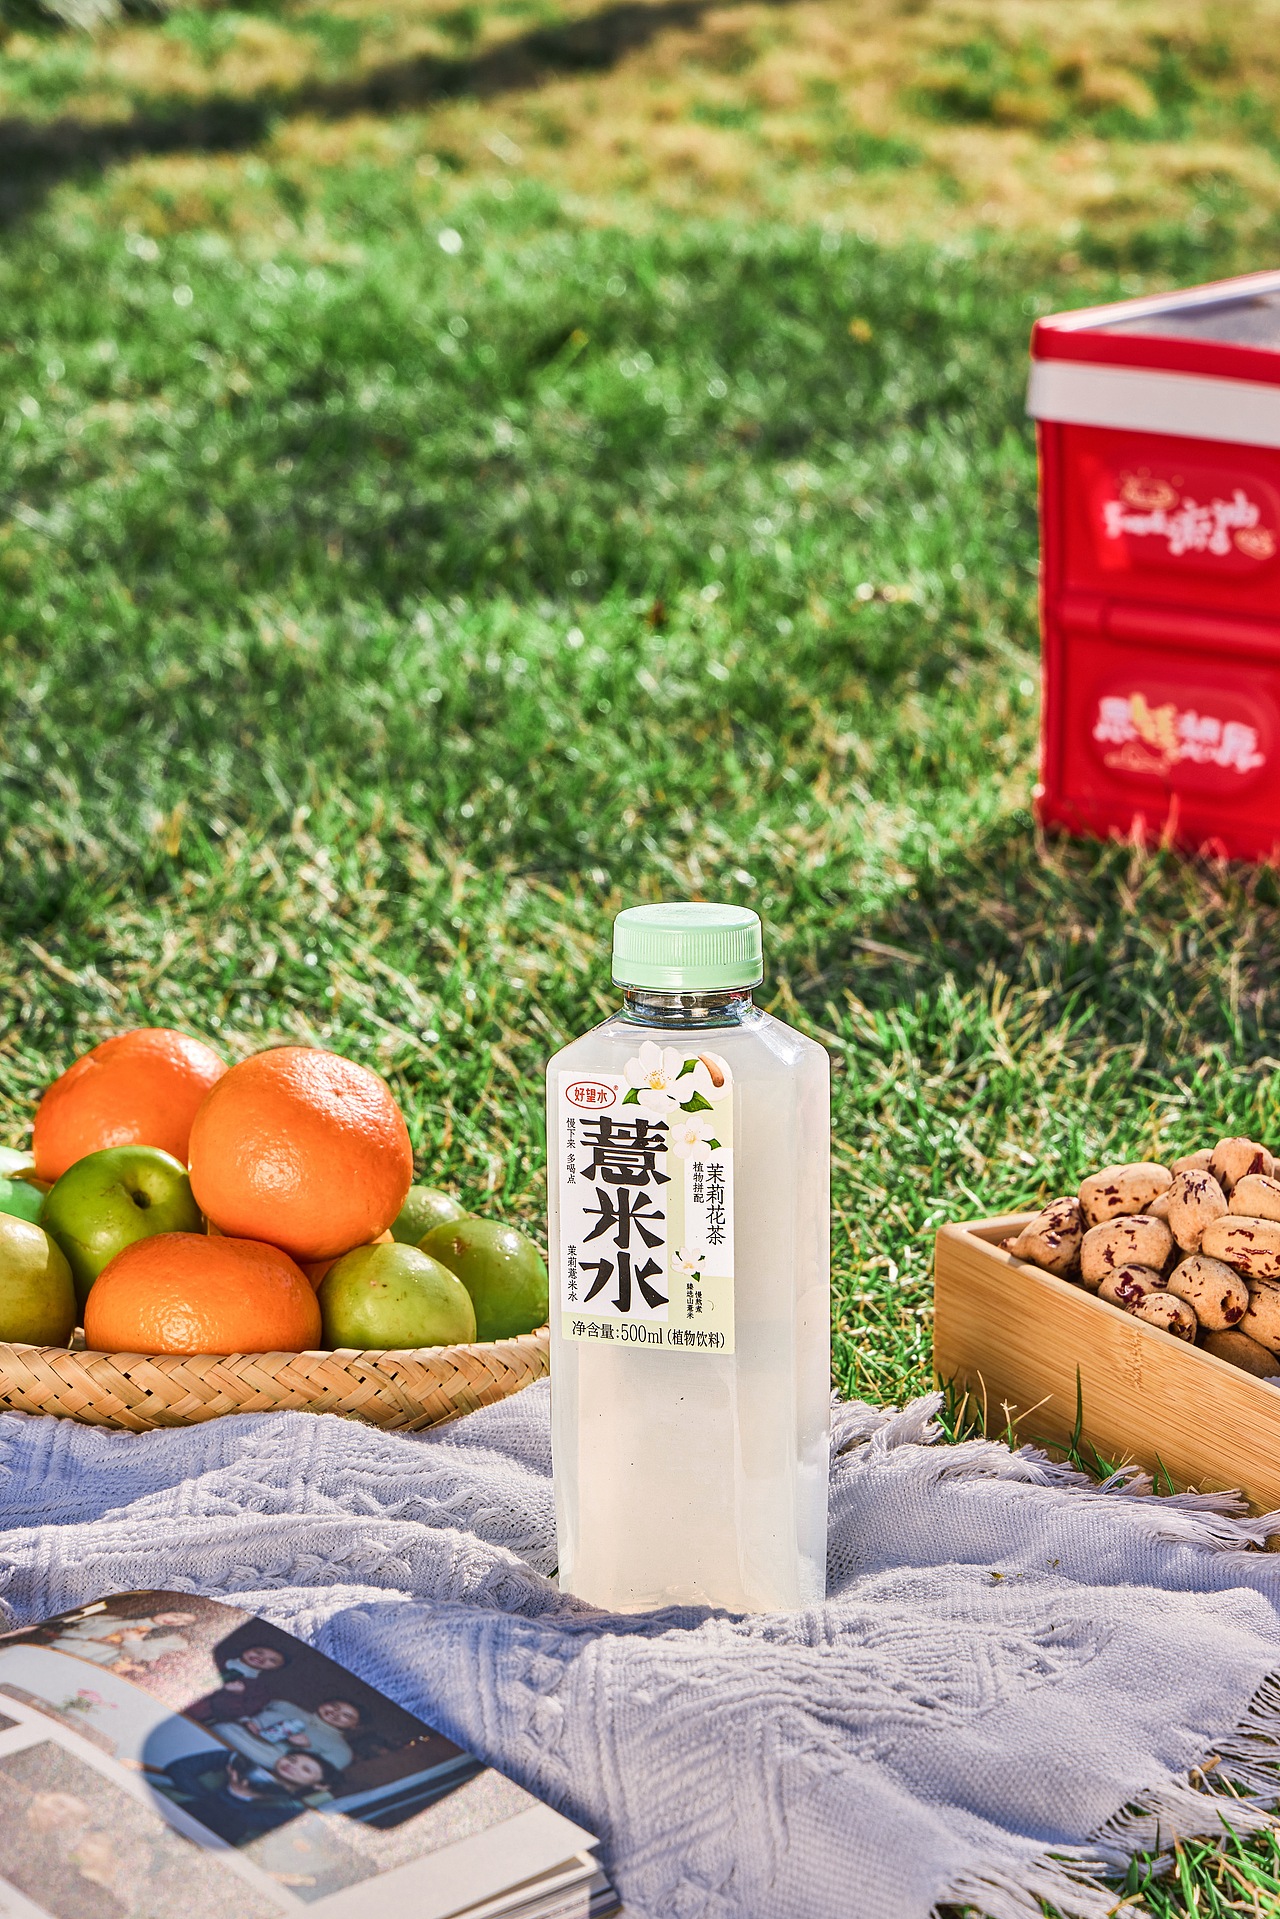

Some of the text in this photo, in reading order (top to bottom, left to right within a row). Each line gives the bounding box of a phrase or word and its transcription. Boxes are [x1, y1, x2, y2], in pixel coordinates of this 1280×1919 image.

[574, 1086, 608, 1104] 好望水
[566, 1117, 577, 1185] 慢下来 多喝点
[692, 1161, 705, 1204] 植物拼配
[705, 1162, 726, 1246] 茉莉花茶
[578, 1115, 672, 1312] 薏米水
[567, 1244, 579, 1302] 茉莉薏米水
[667, 1328, 725, 1349] (植物饮料)
